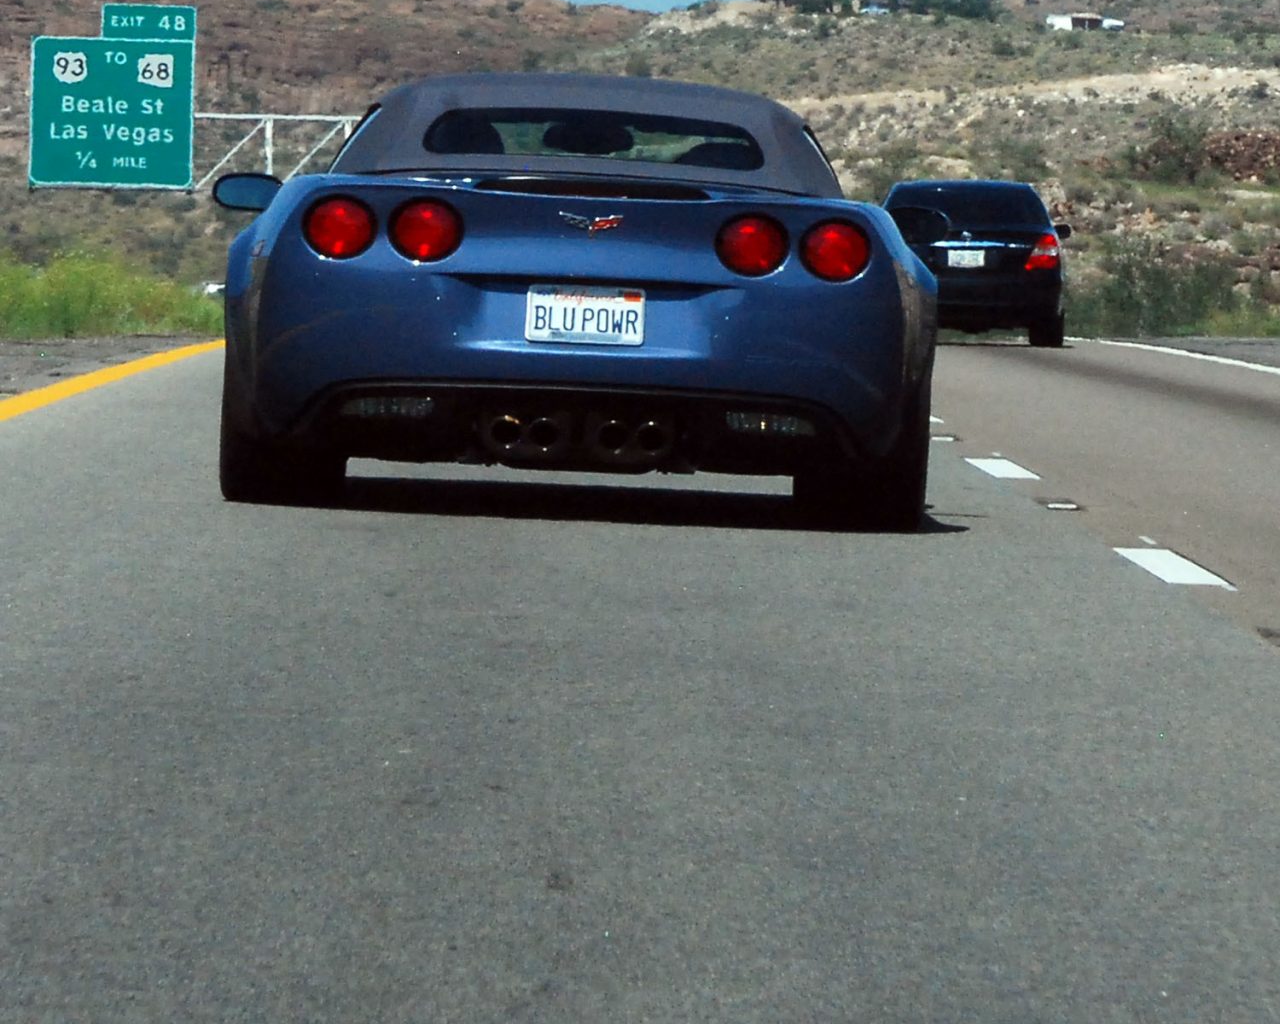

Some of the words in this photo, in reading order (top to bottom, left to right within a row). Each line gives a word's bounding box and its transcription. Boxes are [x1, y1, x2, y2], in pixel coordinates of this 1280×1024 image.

[110, 15, 145, 27] EXIT
[158, 15, 186, 31] 48
[56, 57, 84, 77] 93
[104, 51, 128, 65] TO
[141, 62, 170, 81] 68
[61, 95, 129, 114] Beale
[141, 98, 165, 115] St
[50, 122, 88, 140] Las
[103, 123, 174, 146] Vegas
[112, 156, 148, 169] MILE
